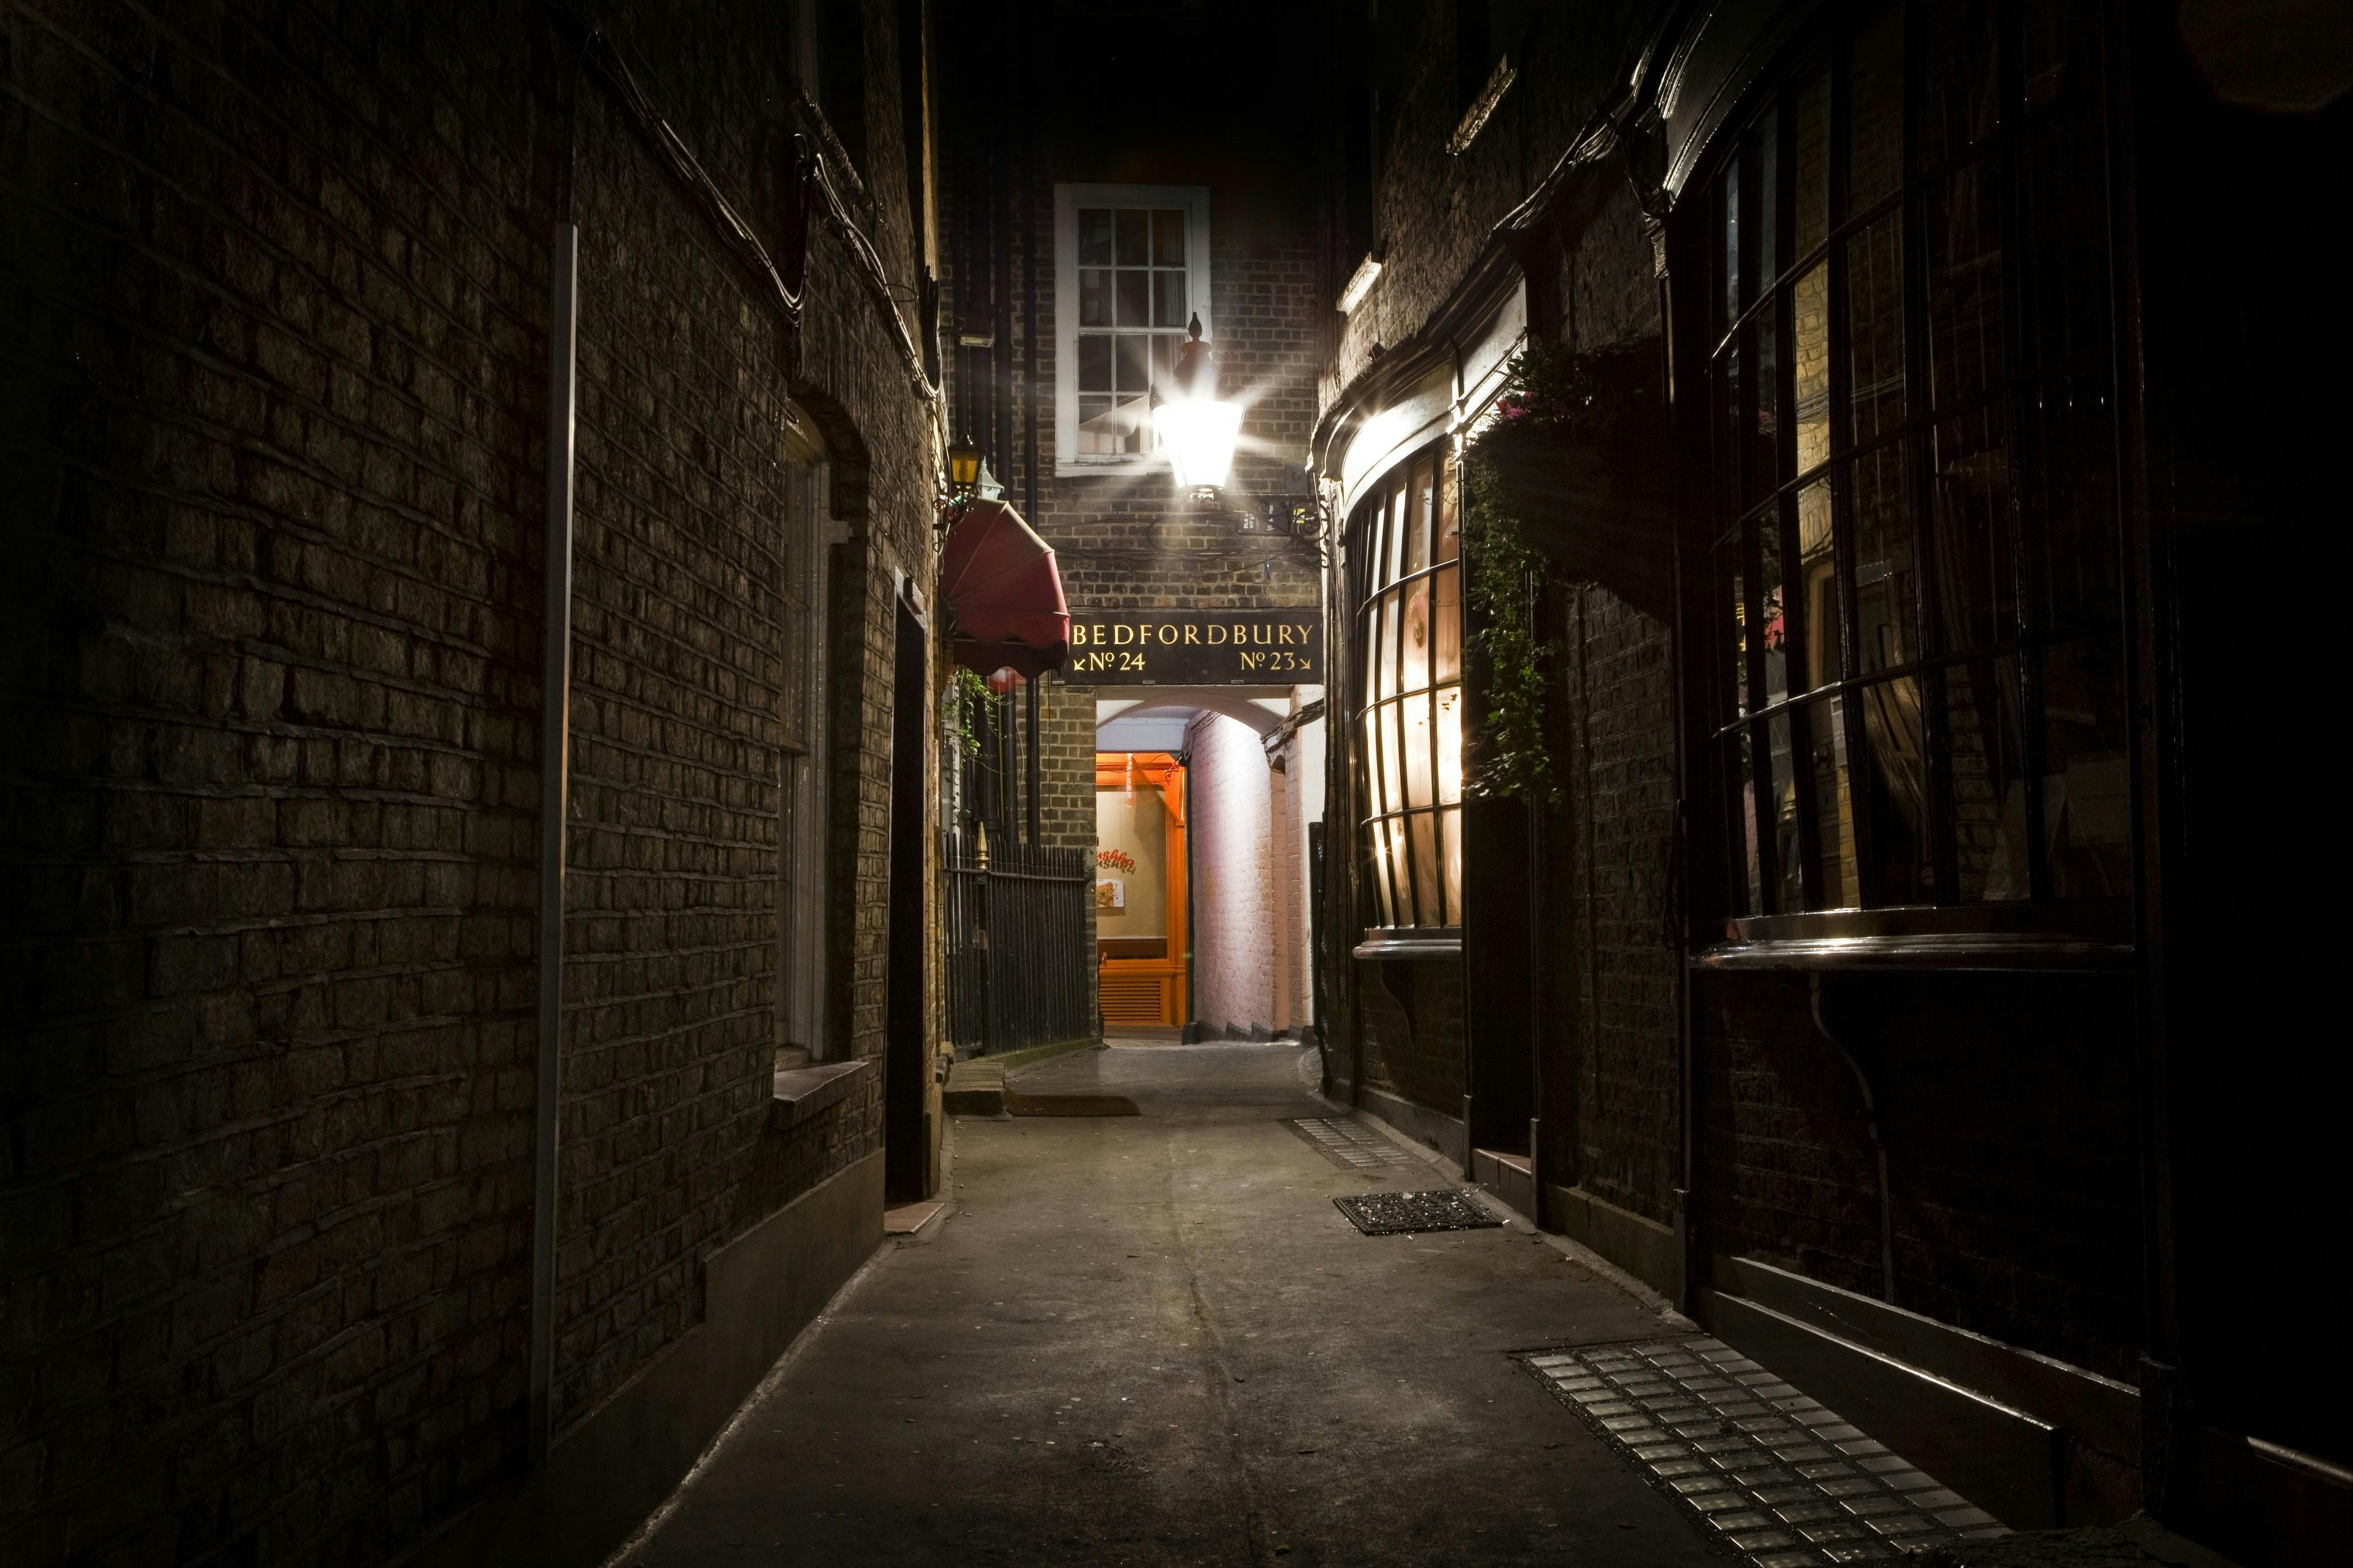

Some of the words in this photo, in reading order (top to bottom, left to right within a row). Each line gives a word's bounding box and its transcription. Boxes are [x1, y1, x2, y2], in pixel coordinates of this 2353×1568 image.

[1072, 624, 1313, 645] BEDFORDBURY
[1119, 652, 1146, 671] 24
[1270, 652, 1295, 671] 23
